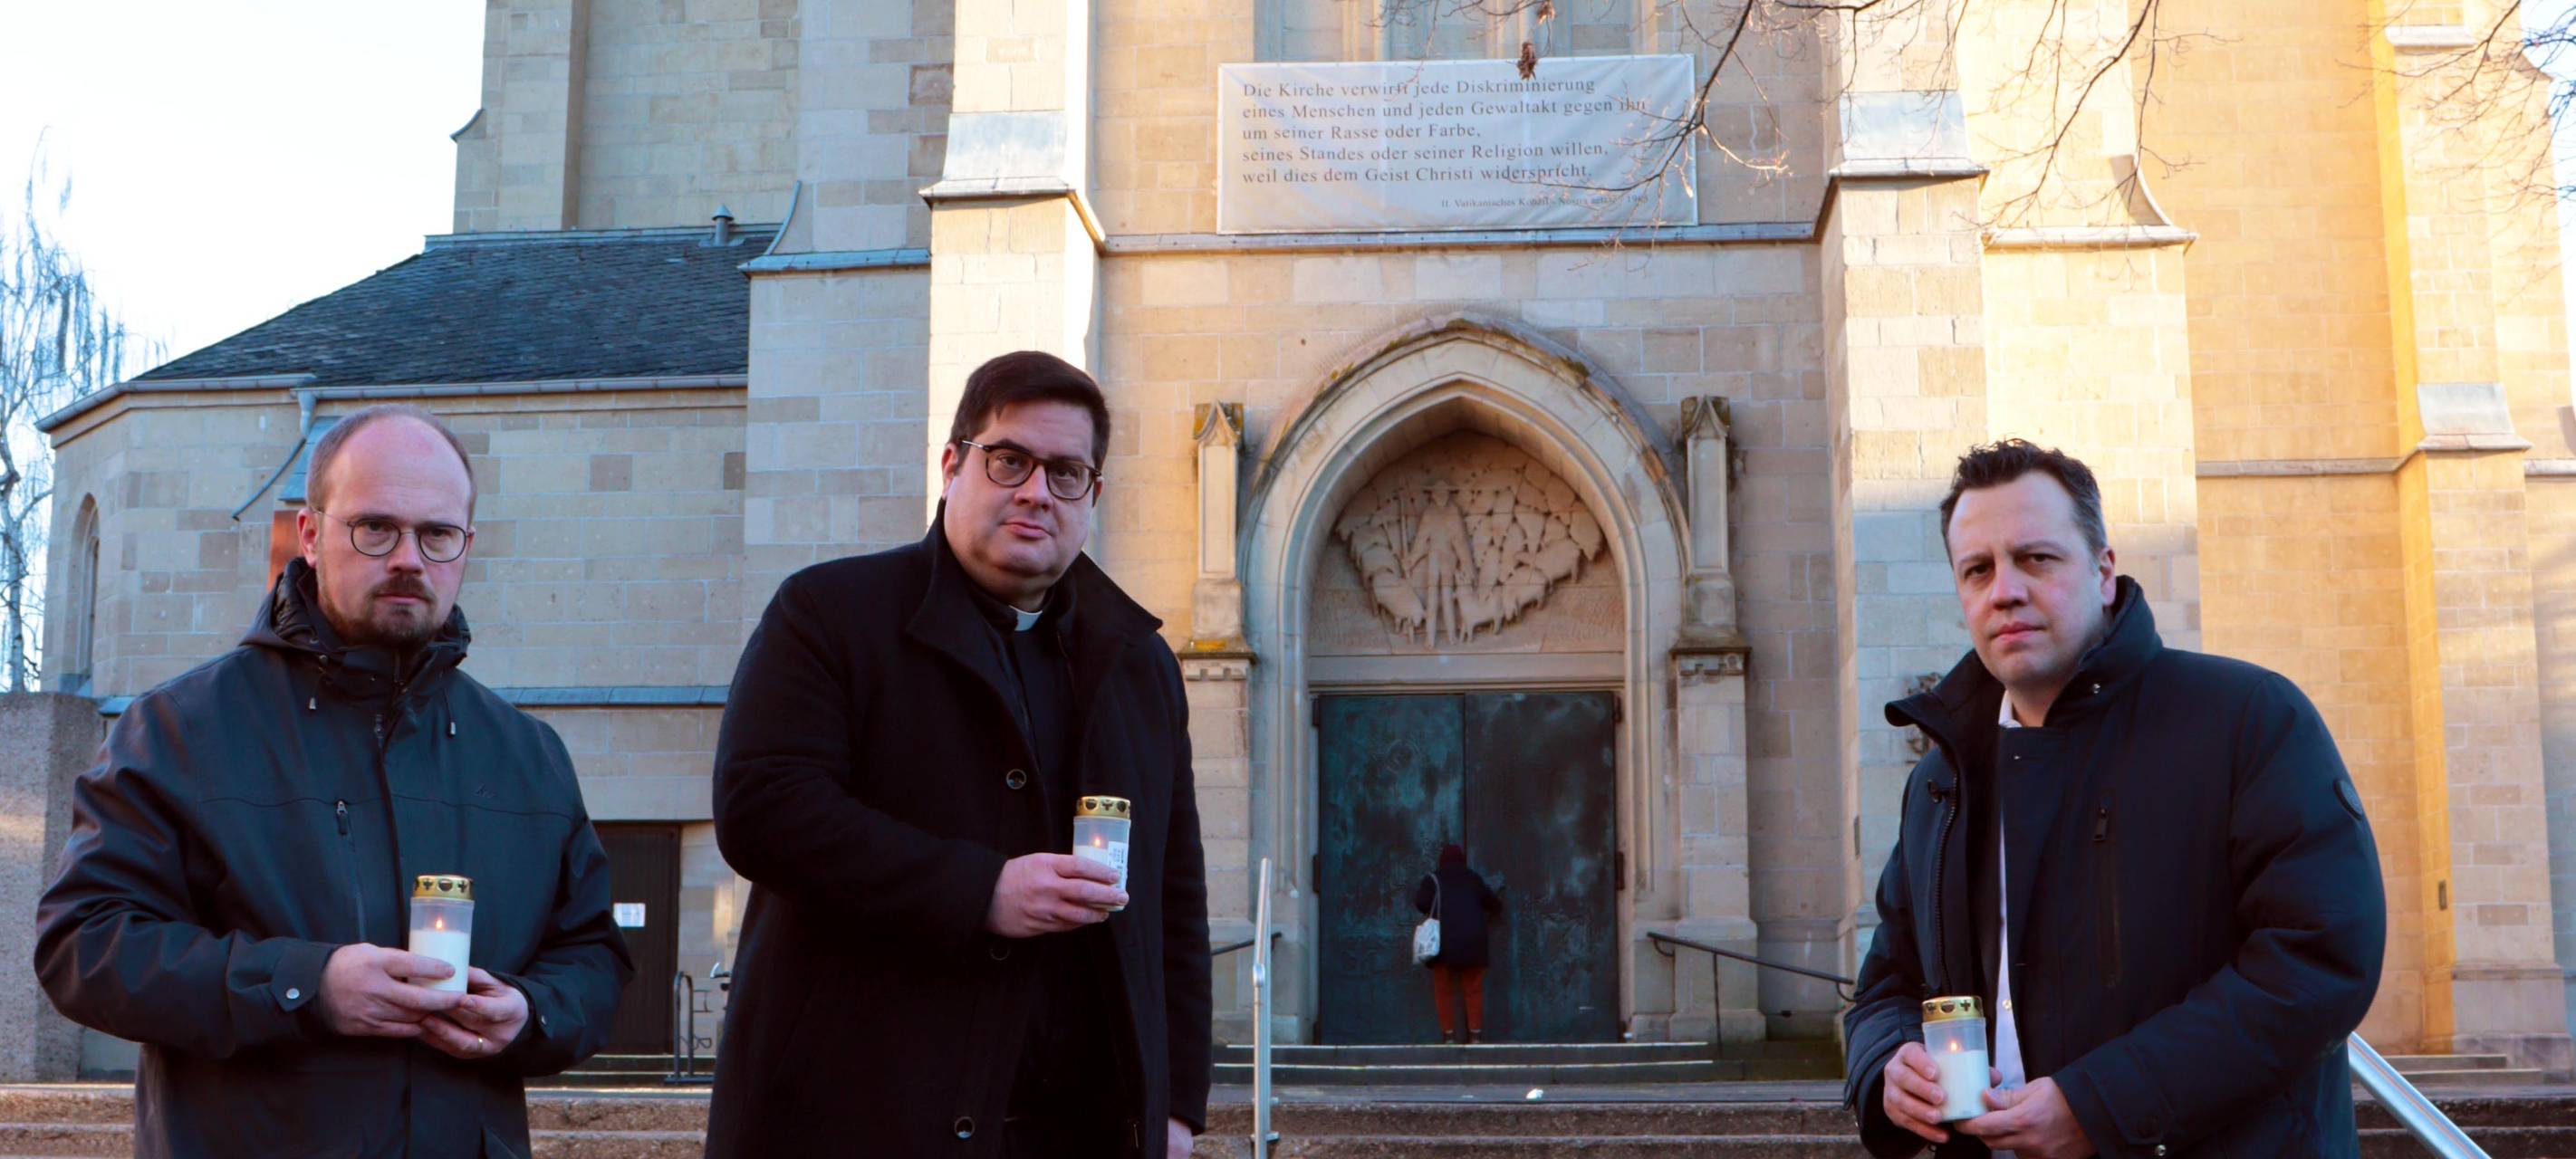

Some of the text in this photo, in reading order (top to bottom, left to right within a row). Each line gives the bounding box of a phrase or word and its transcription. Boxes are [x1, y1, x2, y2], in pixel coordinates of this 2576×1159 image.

[1244, 78, 1595, 98] Die Kirche verwirft jede Diskriminierung
[1243, 105, 1284, 118] eines
[1293, 105, 1375, 118] Menschen
[1383, 103, 1412, 117] und
[1418, 102, 1464, 120] jeden
[1471, 101, 1556, 115] Gewaltakt
[1563, 102, 1612, 116] gegen
[1243, 129, 1267, 139] um
[1274, 127, 1324, 139] seiner
[1331, 126, 1379, 139] Rasse
[1385, 124, 1422, 138] oder
[1242, 149, 1293, 162] seines
[1300, 147, 1364, 160] Standes
[1370, 147, 1408, 160] oder
[1414, 146, 1465, 158] seiner
[1472, 143, 1543, 160] Religion
[1243, 169, 1276, 183] weil
[1284, 168, 1316, 182] dies
[1323, 168, 1358, 181] dem
[1365, 168, 1408, 181] Geist
[1416, 167, 1473, 181] Christi
